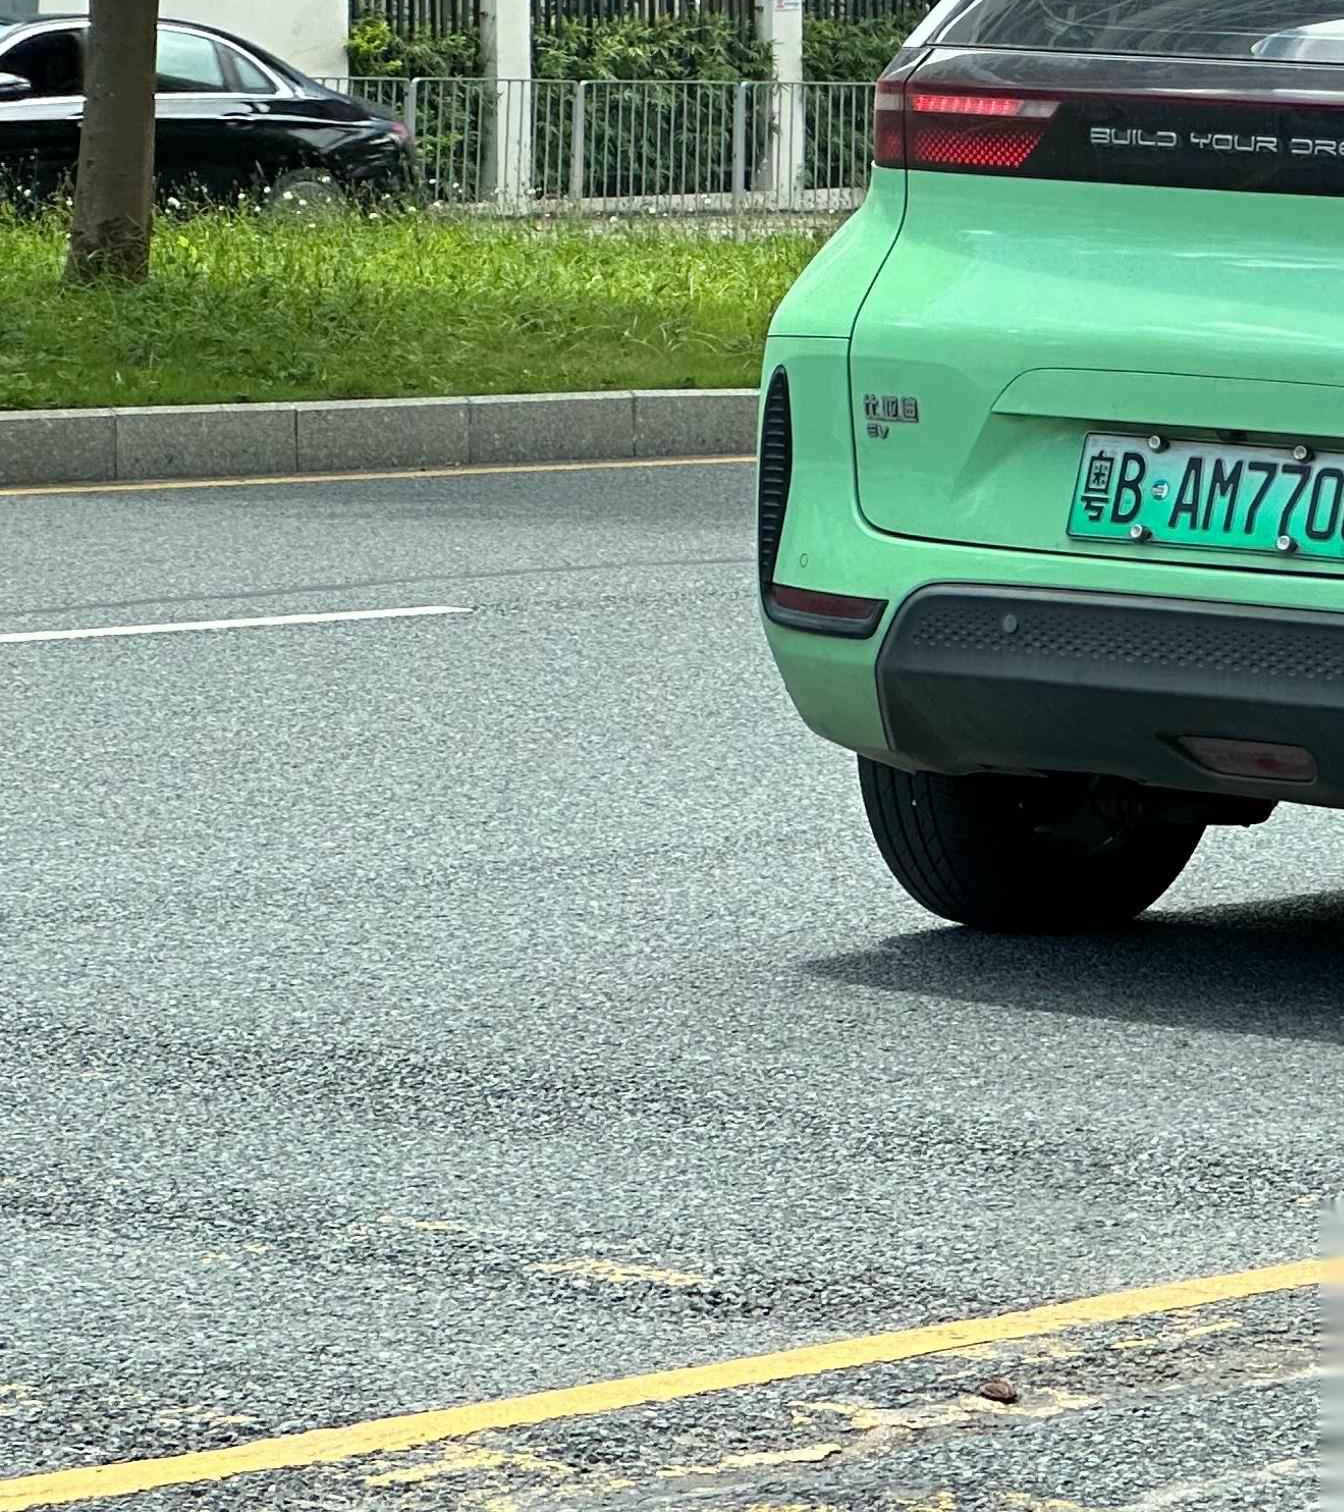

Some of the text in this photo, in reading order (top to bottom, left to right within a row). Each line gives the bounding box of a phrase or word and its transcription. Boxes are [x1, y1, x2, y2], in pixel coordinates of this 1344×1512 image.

[1090, 127, 1177, 148] BUILD
[1190, 131, 1278, 153] YOUR
[867, 423, 889, 439] EV
